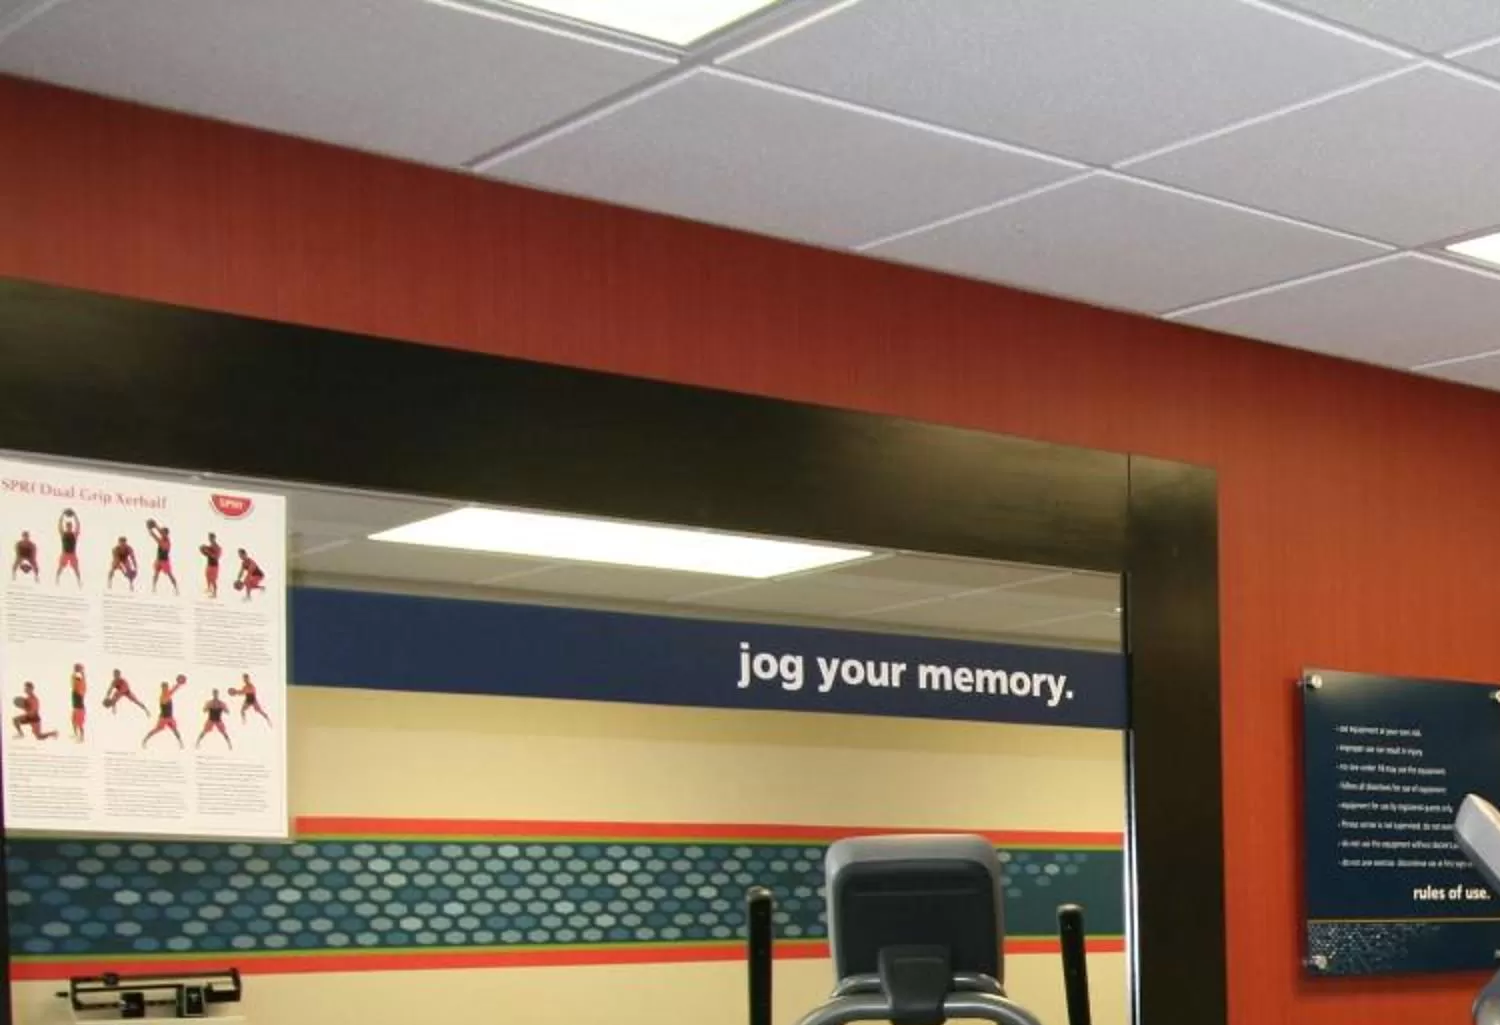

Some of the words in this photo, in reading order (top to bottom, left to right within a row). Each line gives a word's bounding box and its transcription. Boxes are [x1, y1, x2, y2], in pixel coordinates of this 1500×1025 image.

[737, 641, 804, 690] jog
[817, 656, 907, 692] your
[917, 662, 1075, 707] memory.
[1413, 884, 1446, 900] rules
[1448, 883, 1463, 899] of
[1465, 885, 1492, 900] use.
